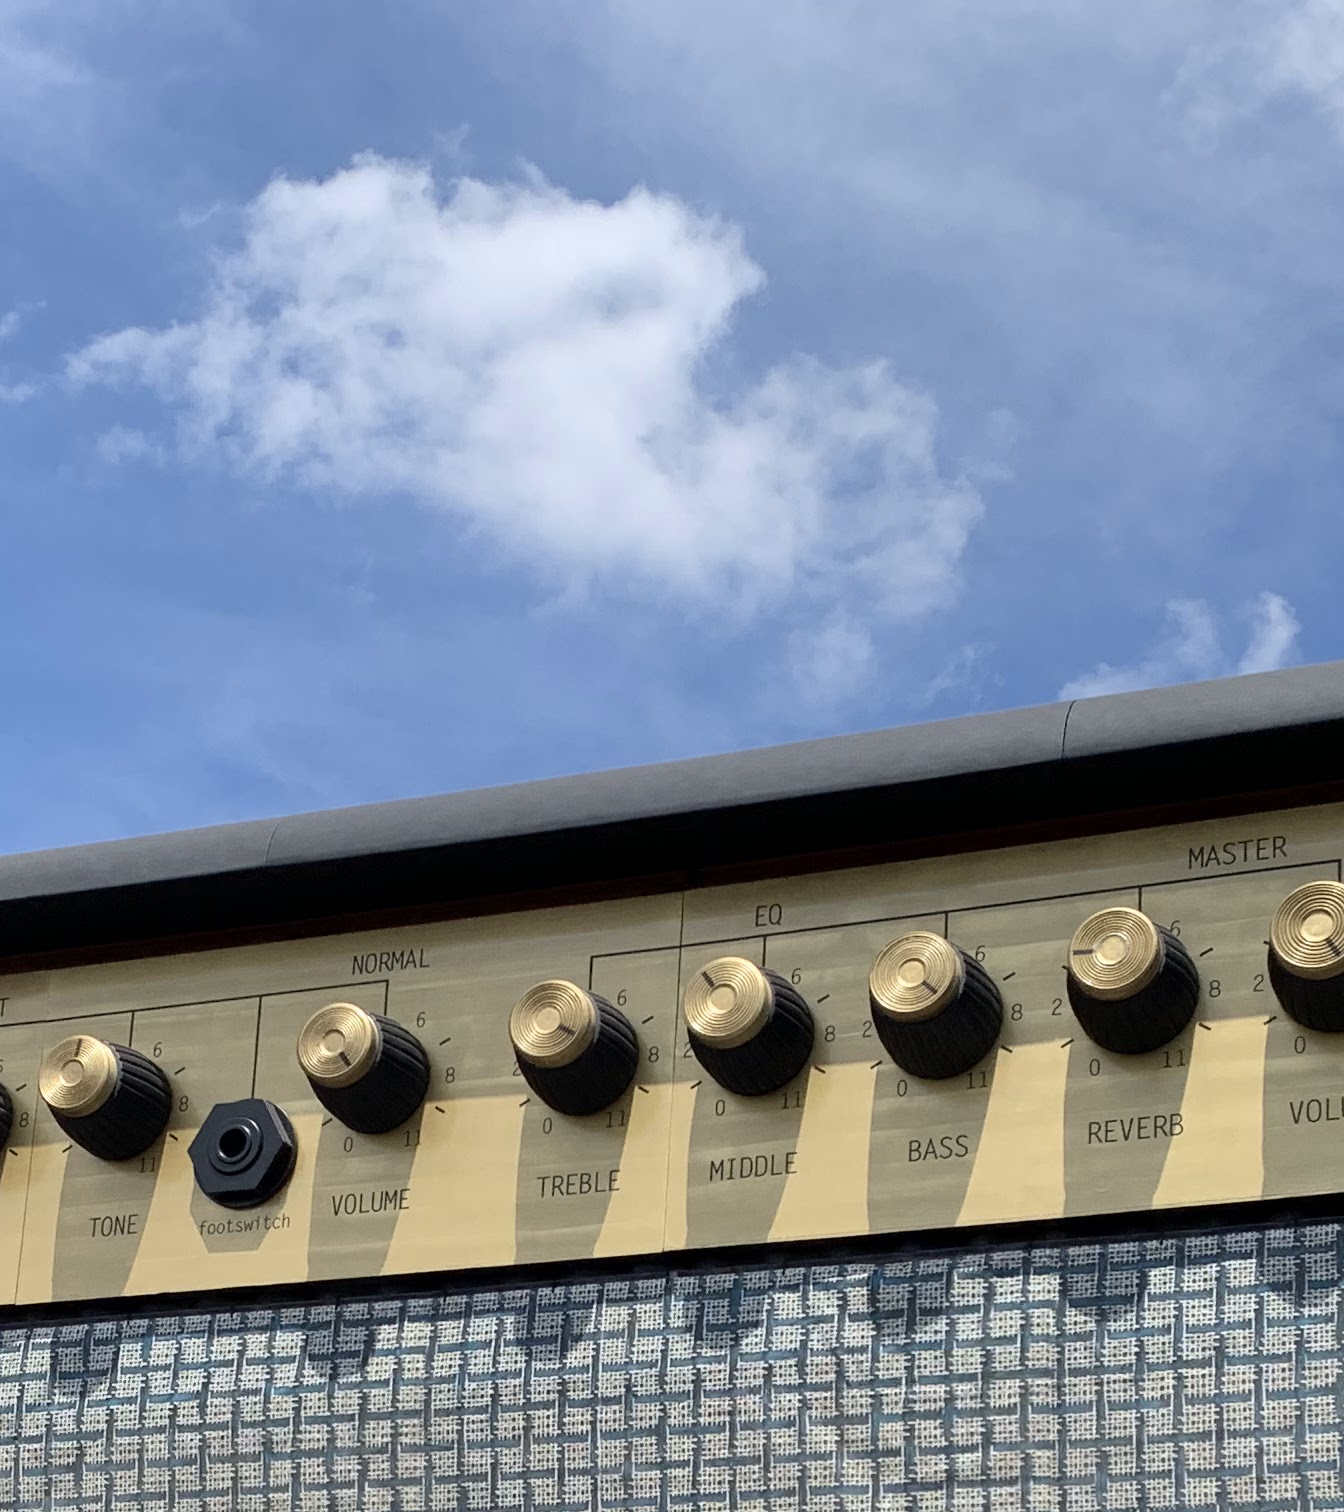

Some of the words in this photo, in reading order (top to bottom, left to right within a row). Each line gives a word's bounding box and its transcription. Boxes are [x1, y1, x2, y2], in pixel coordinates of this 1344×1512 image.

[1188, 836, 1287, 870] MASTER
[755, 904, 782, 928] EQ
[1170, 919, 1181, 938] 6
[352, 948, 430, 975] NORMAL
[975, 944, 986, 962] 6
[791, 967, 802, 985] 6
[1253, 974, 1265, 993] 2
[617, 989, 628, 1007] 6
[1209, 979, 1222, 998] 8
[1011, 1003, 1023, 1021] 8
[1051, 997, 1063, 1016] 2
[416, 1011, 427, 1029] 6
[862, 1020, 873, 1039] 2
[824, 1024, 836, 1042] 8
[152, 1041, 163, 1058] 6
[648, 1045, 660, 1063] 8
[1162, 1048, 1186, 1069] 11
[444, 1067, 456, 1084] 8
[966, 1071, 988, 1091] 11
[179, 1095, 189, 1112] 8
[781, 1090, 802, 1110] 11
[18, 1111, 30, 1128] 8
[606, 1110, 627, 1129] 11
[1088, 1112, 1185, 1145] REVERB
[403, 1129, 421, 1147] 11
[907, 1134, 970, 1163] BASS
[138, 1157, 156, 1174] 11
[709, 1150, 799, 1182] MIDDLE
[537, 1169, 622, 1198] TREBLE
[331, 1188, 410, 1217] VOLUME
[89, 1214, 139, 1239] TONE
[199, 1213, 291, 1236] footswitch
